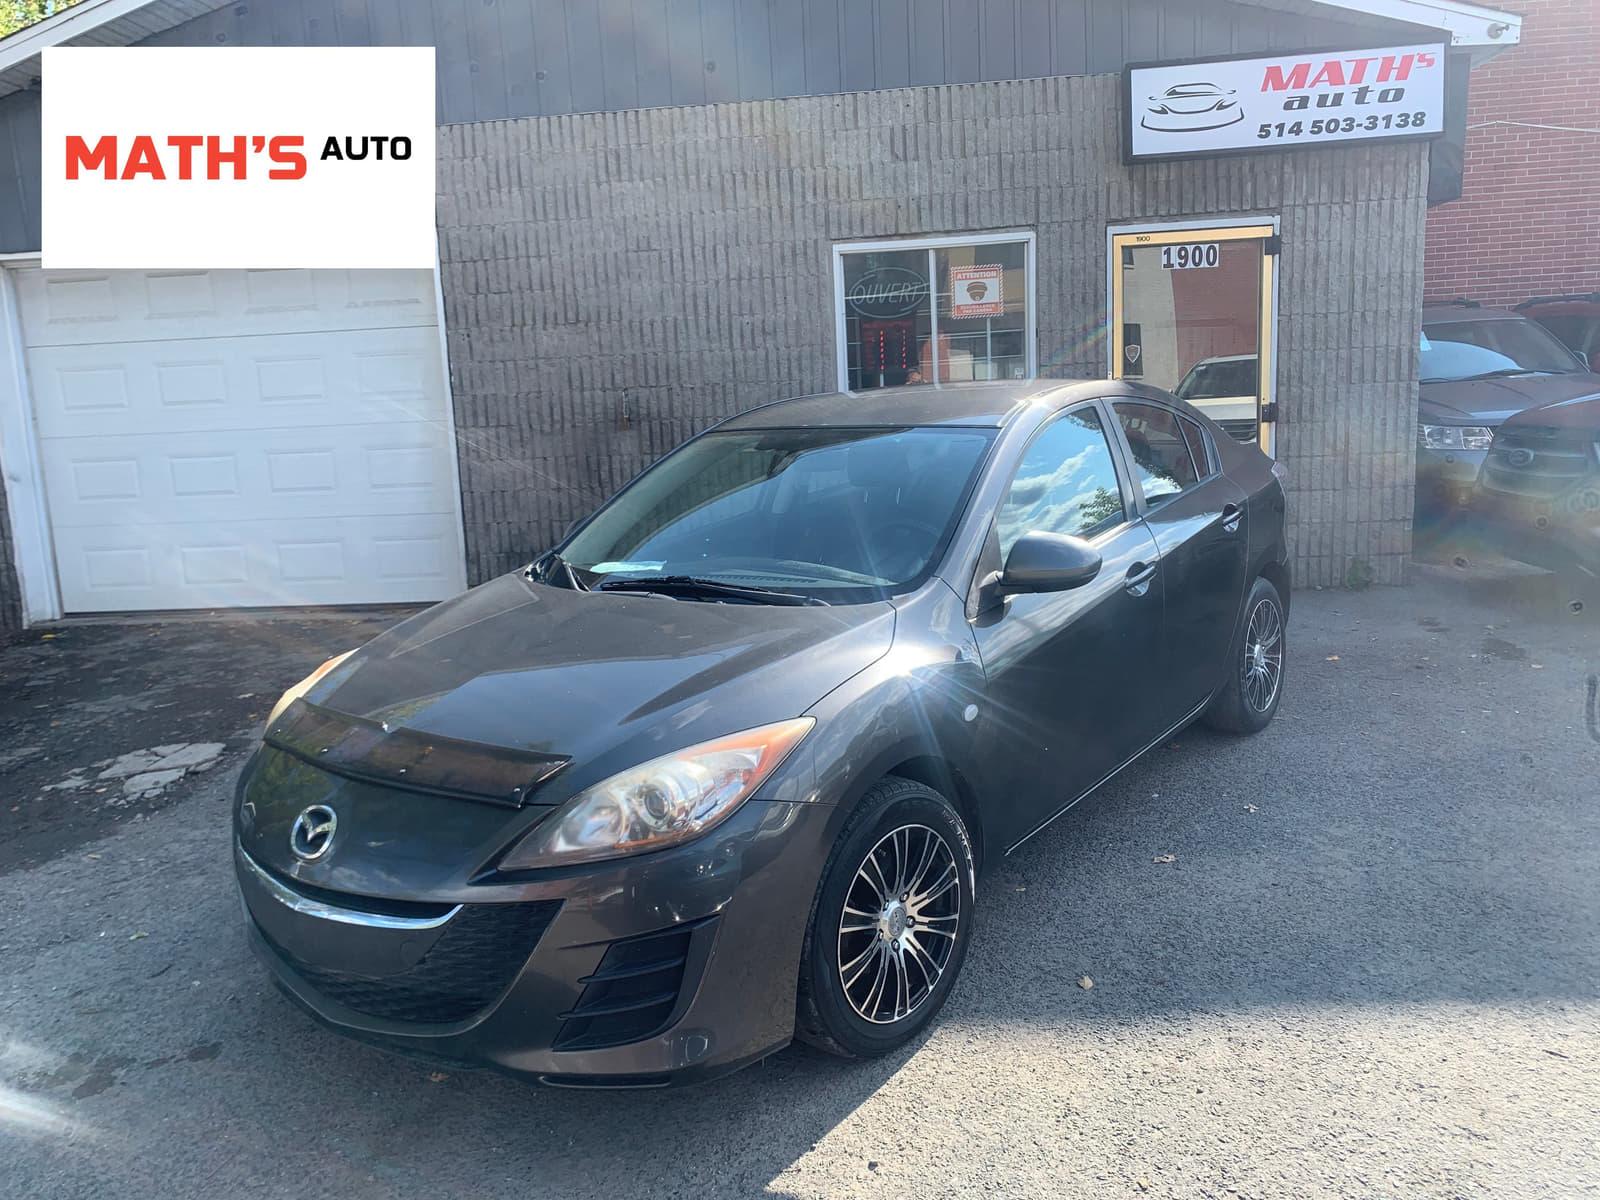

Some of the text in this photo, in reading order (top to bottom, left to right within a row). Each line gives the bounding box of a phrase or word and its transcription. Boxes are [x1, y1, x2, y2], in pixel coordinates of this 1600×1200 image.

[1283, 85, 1405, 111] auto
[1257, 112, 1426, 139] 514 503-3138
[1163, 245, 1218, 269] 1900
[956, 270, 997, 280] ATTENTION
[853, 281, 922, 305] OUVERT
